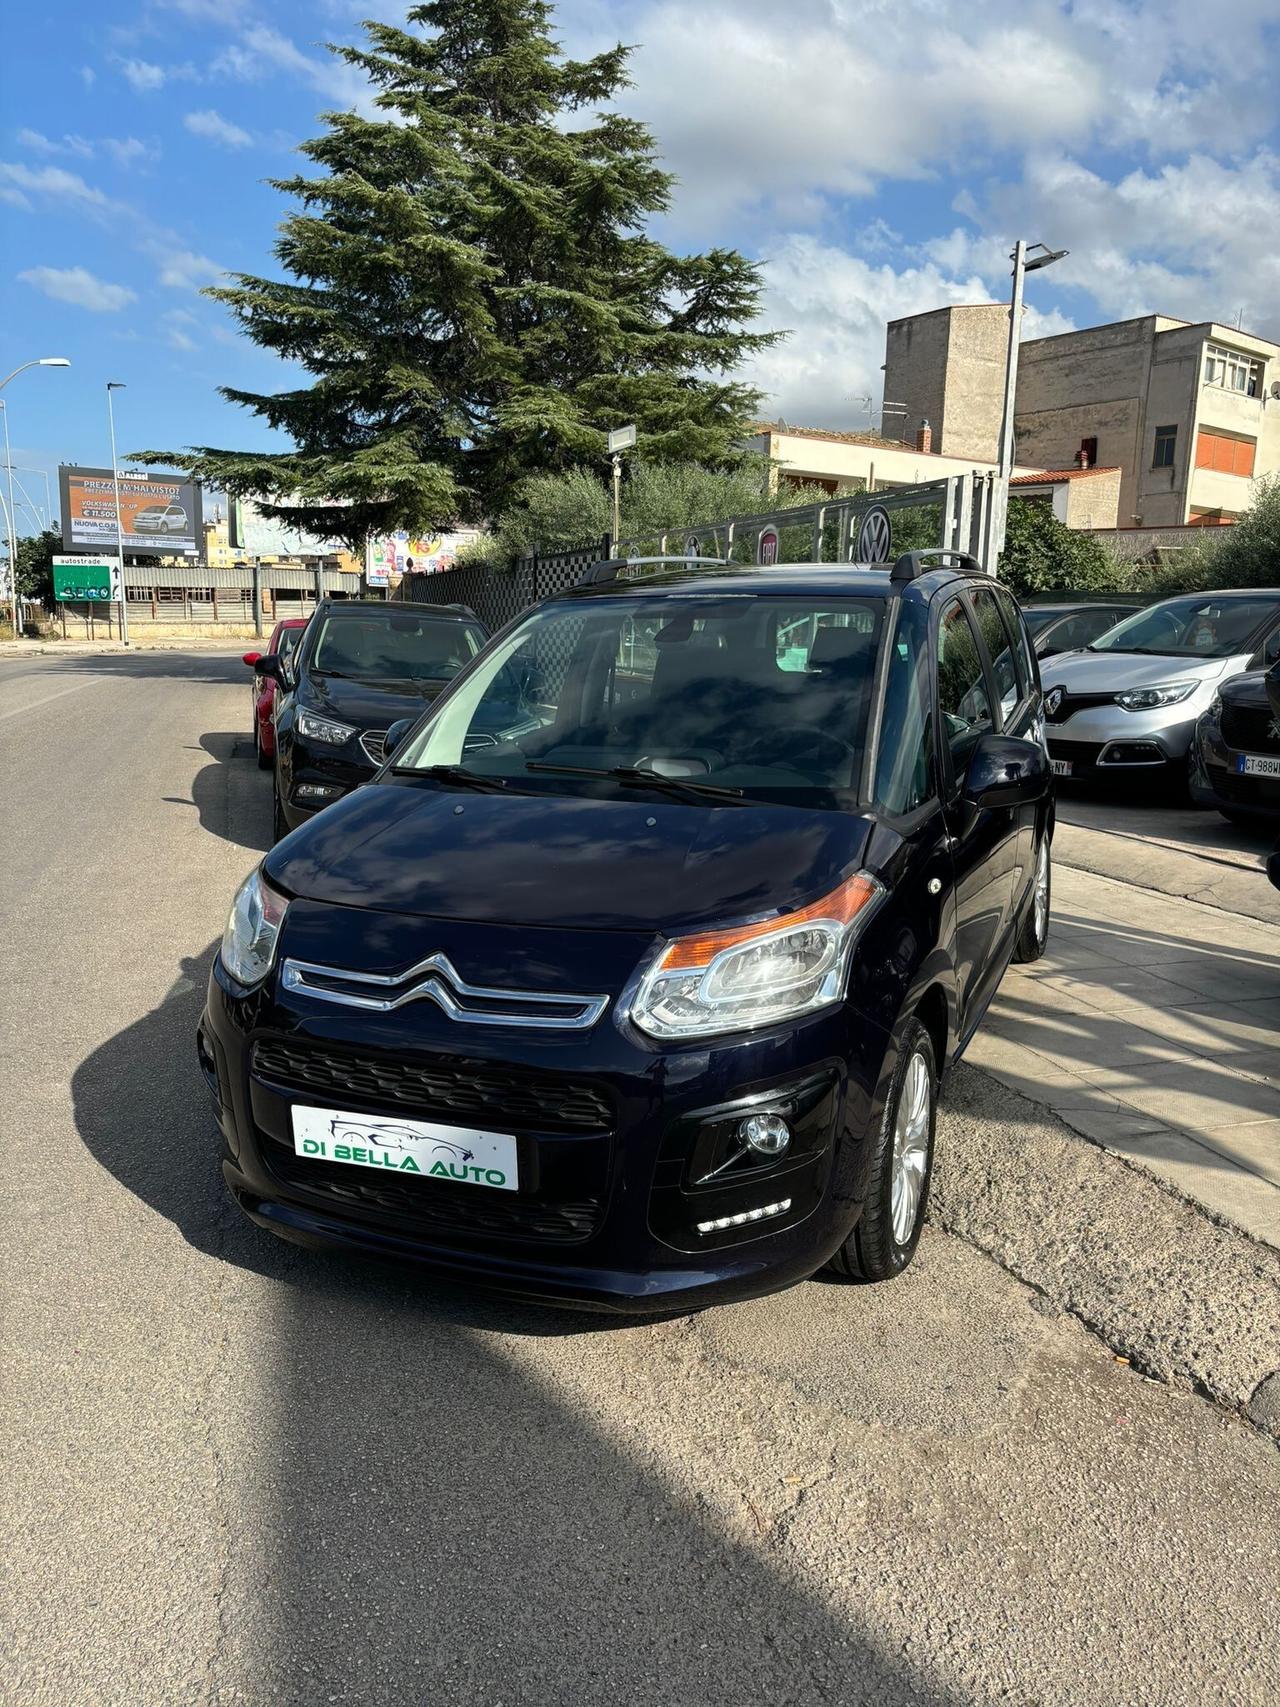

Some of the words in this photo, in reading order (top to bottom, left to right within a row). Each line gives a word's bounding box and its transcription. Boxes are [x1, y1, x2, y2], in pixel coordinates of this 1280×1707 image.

[151, 486, 180, 495] VISTO?
[82, 501, 125, 509] VOLKSWAGN
[92, 510, 117, 518] 11.500
[74, 520, 98, 528] NUOVA
[303, 1139, 326, 1156] DI
[334, 1144, 421, 1172] BELLA
[429, 1160, 507, 1186] AUTO
